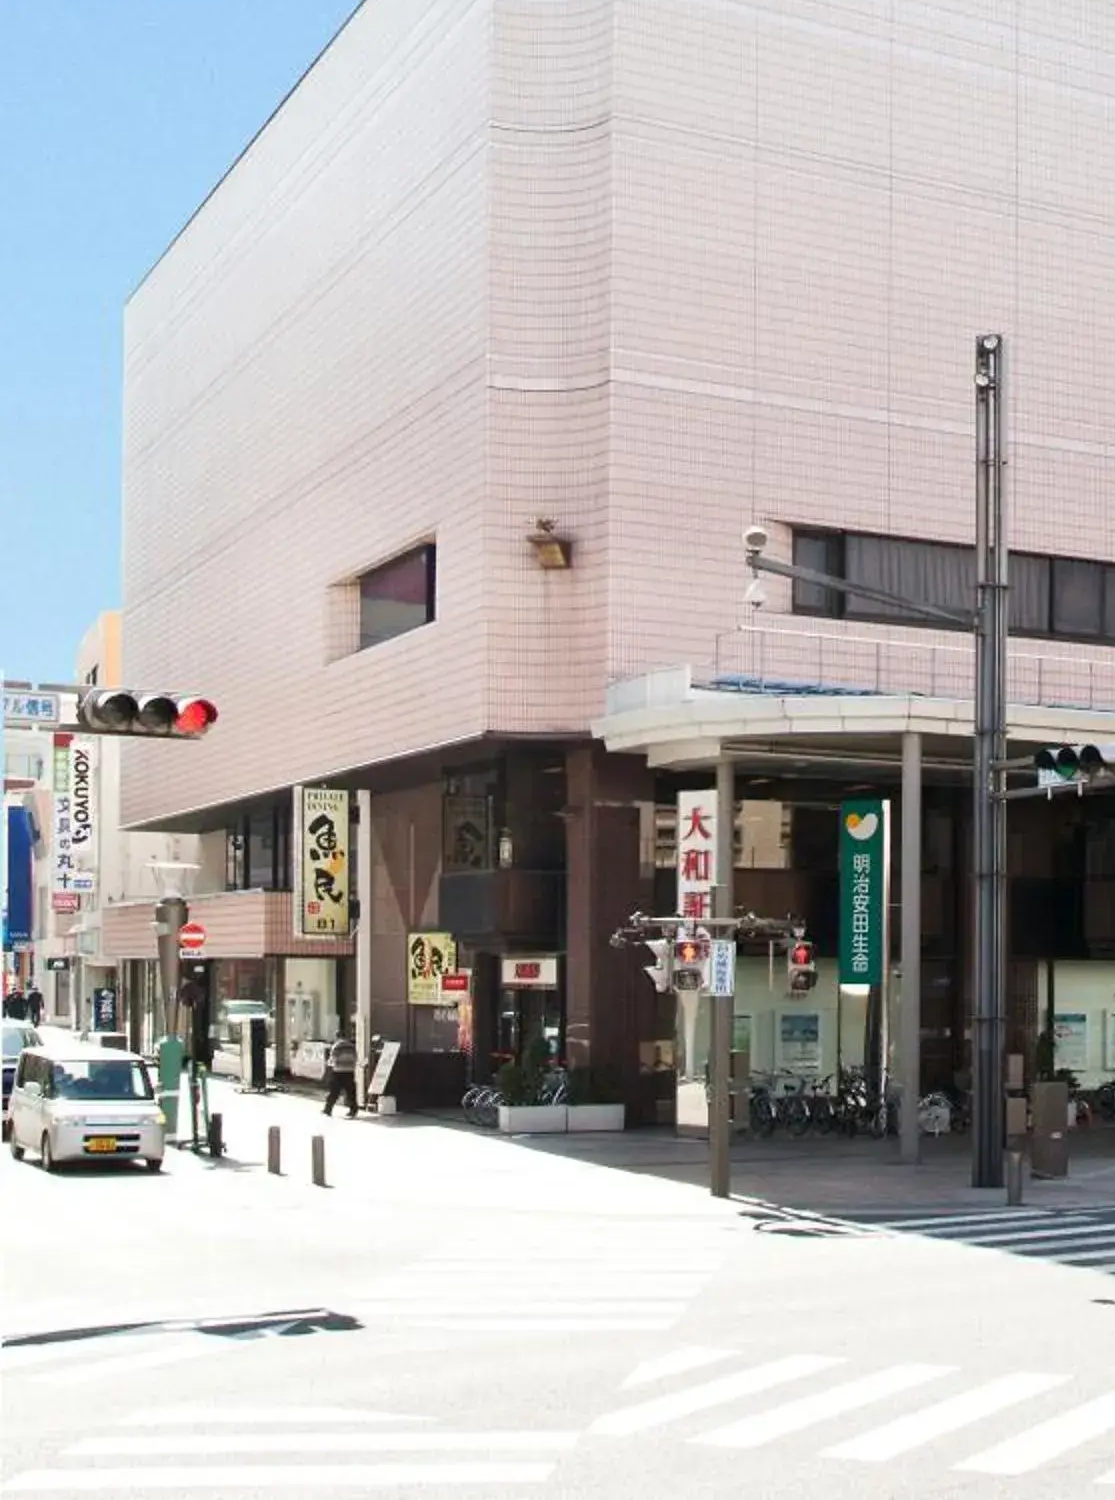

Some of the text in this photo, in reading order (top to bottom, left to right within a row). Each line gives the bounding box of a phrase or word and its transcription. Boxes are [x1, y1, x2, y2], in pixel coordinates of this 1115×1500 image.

[74, 749, 89, 823] KOKUYO
[308, 813, 345, 903] 魚民
[682, 806, 711, 956] 大和証
[852, 853, 871, 973] 明治安田生命
